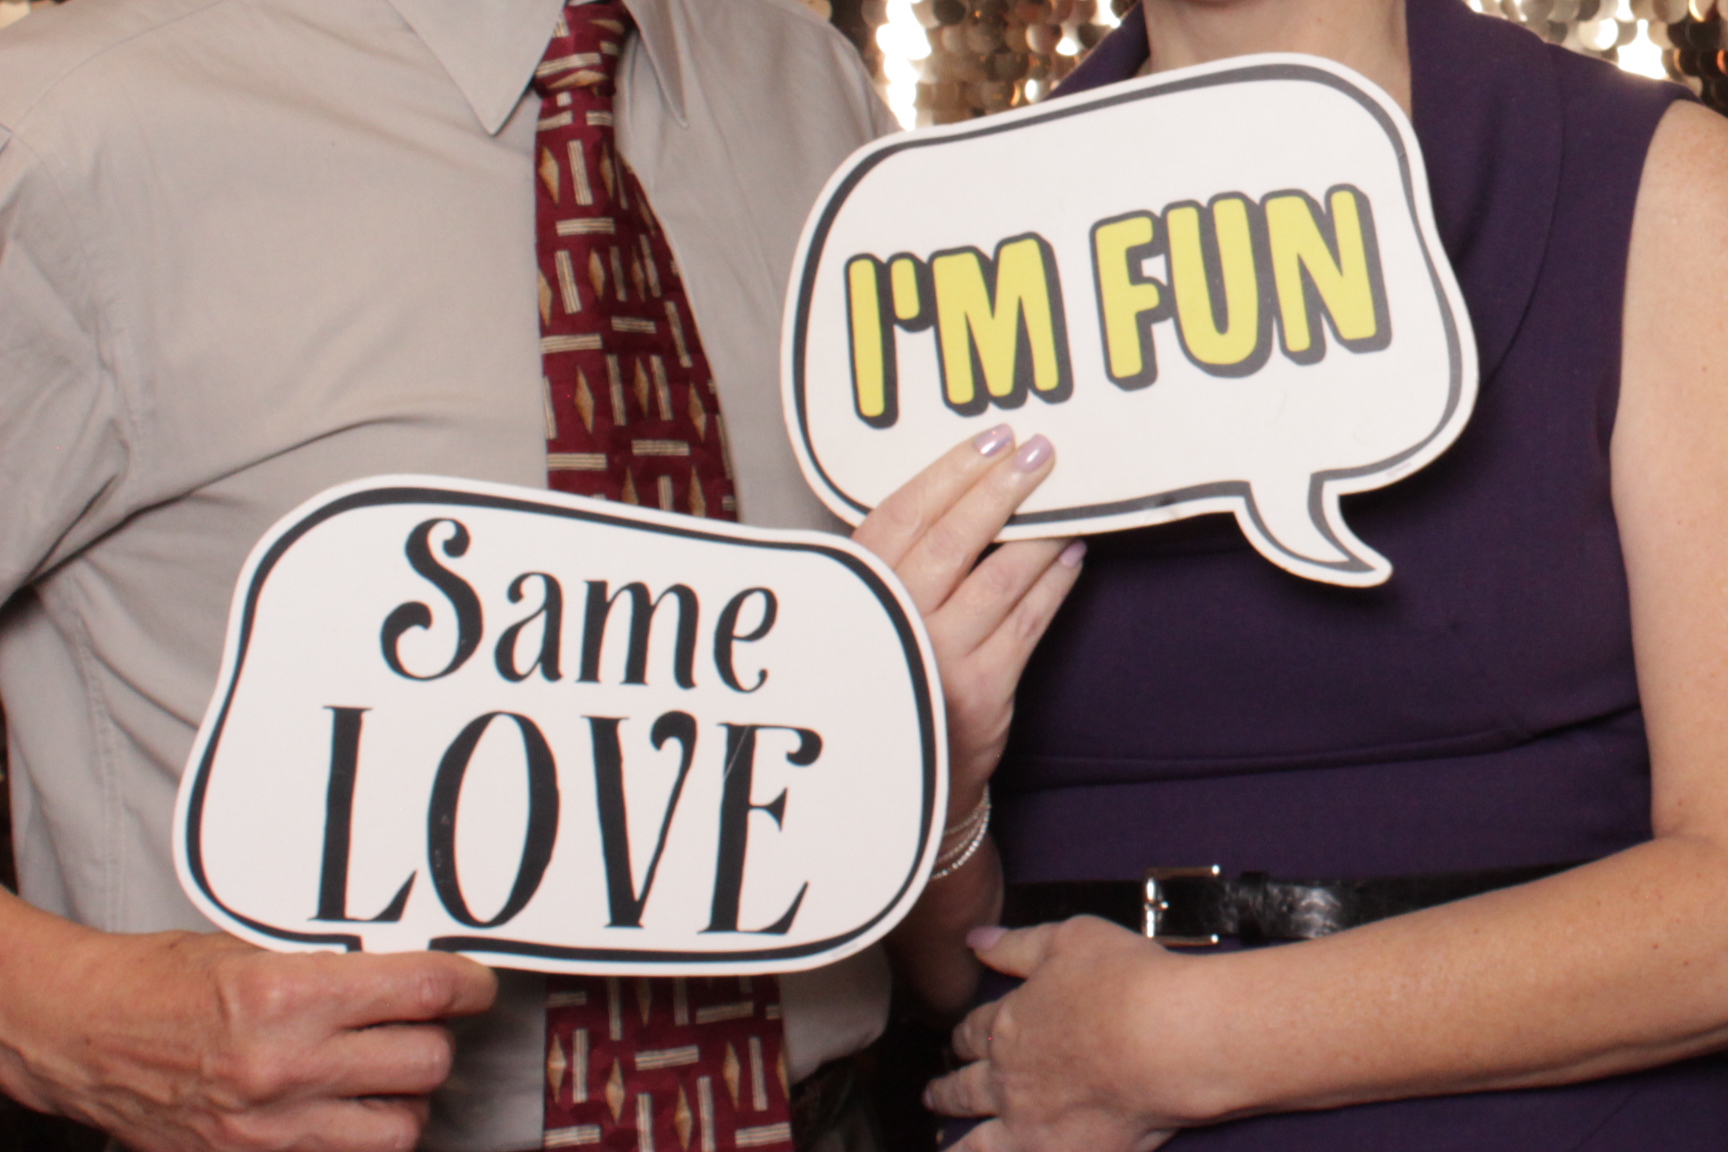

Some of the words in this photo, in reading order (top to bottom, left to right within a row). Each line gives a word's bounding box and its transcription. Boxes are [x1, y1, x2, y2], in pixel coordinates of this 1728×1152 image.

[844, 231, 1073, 429] I'M
[1089, 183, 1392, 391] FUN
[380, 517, 778, 693] Same
[308, 705, 823, 935] LOVE
